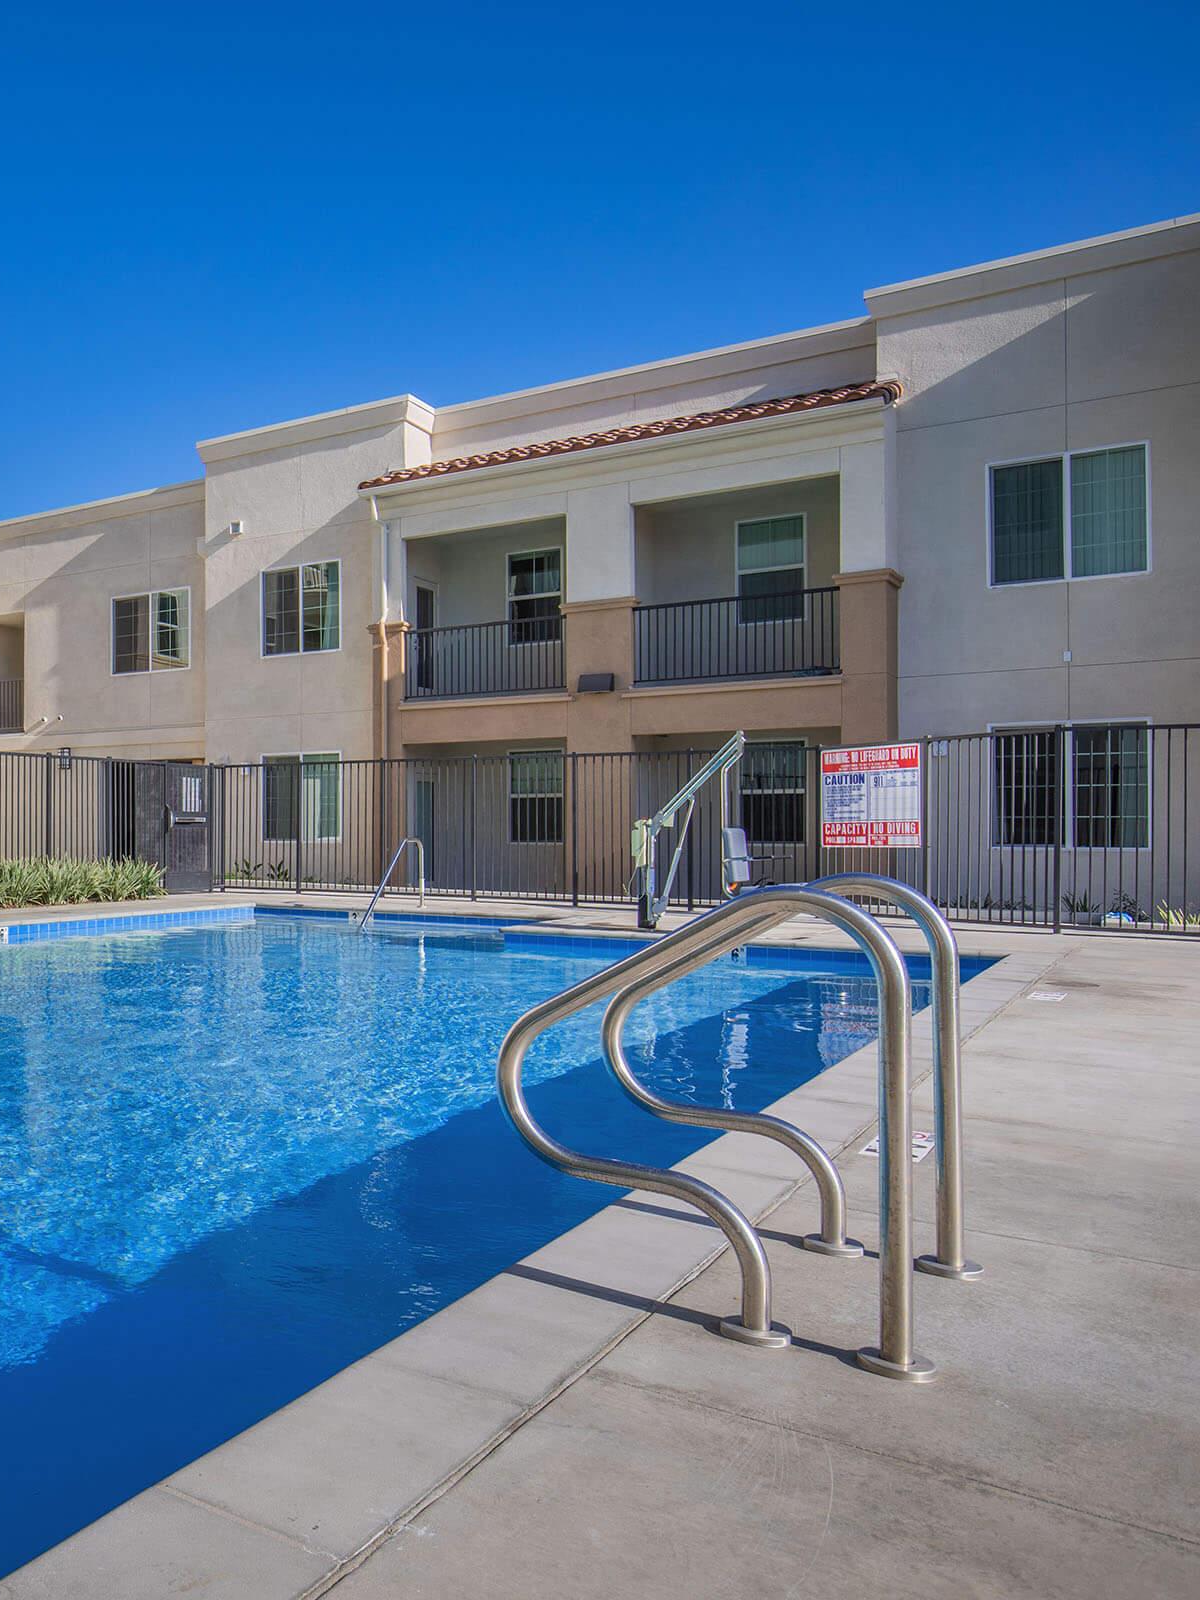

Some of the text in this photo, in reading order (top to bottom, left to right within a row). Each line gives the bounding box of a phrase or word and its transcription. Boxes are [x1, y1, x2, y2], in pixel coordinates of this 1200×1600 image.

[860, 748, 890, 762] LIFEGUARD
[891, 748, 899, 760] ON
[900, 746, 916, 760] DUTY
[824, 773, 865, 786] CAUTION
[873, 775, 883, 788] 911
[824, 823, 867, 836] CAPACITY
[873, 822, 916, 834] NO DIVING
